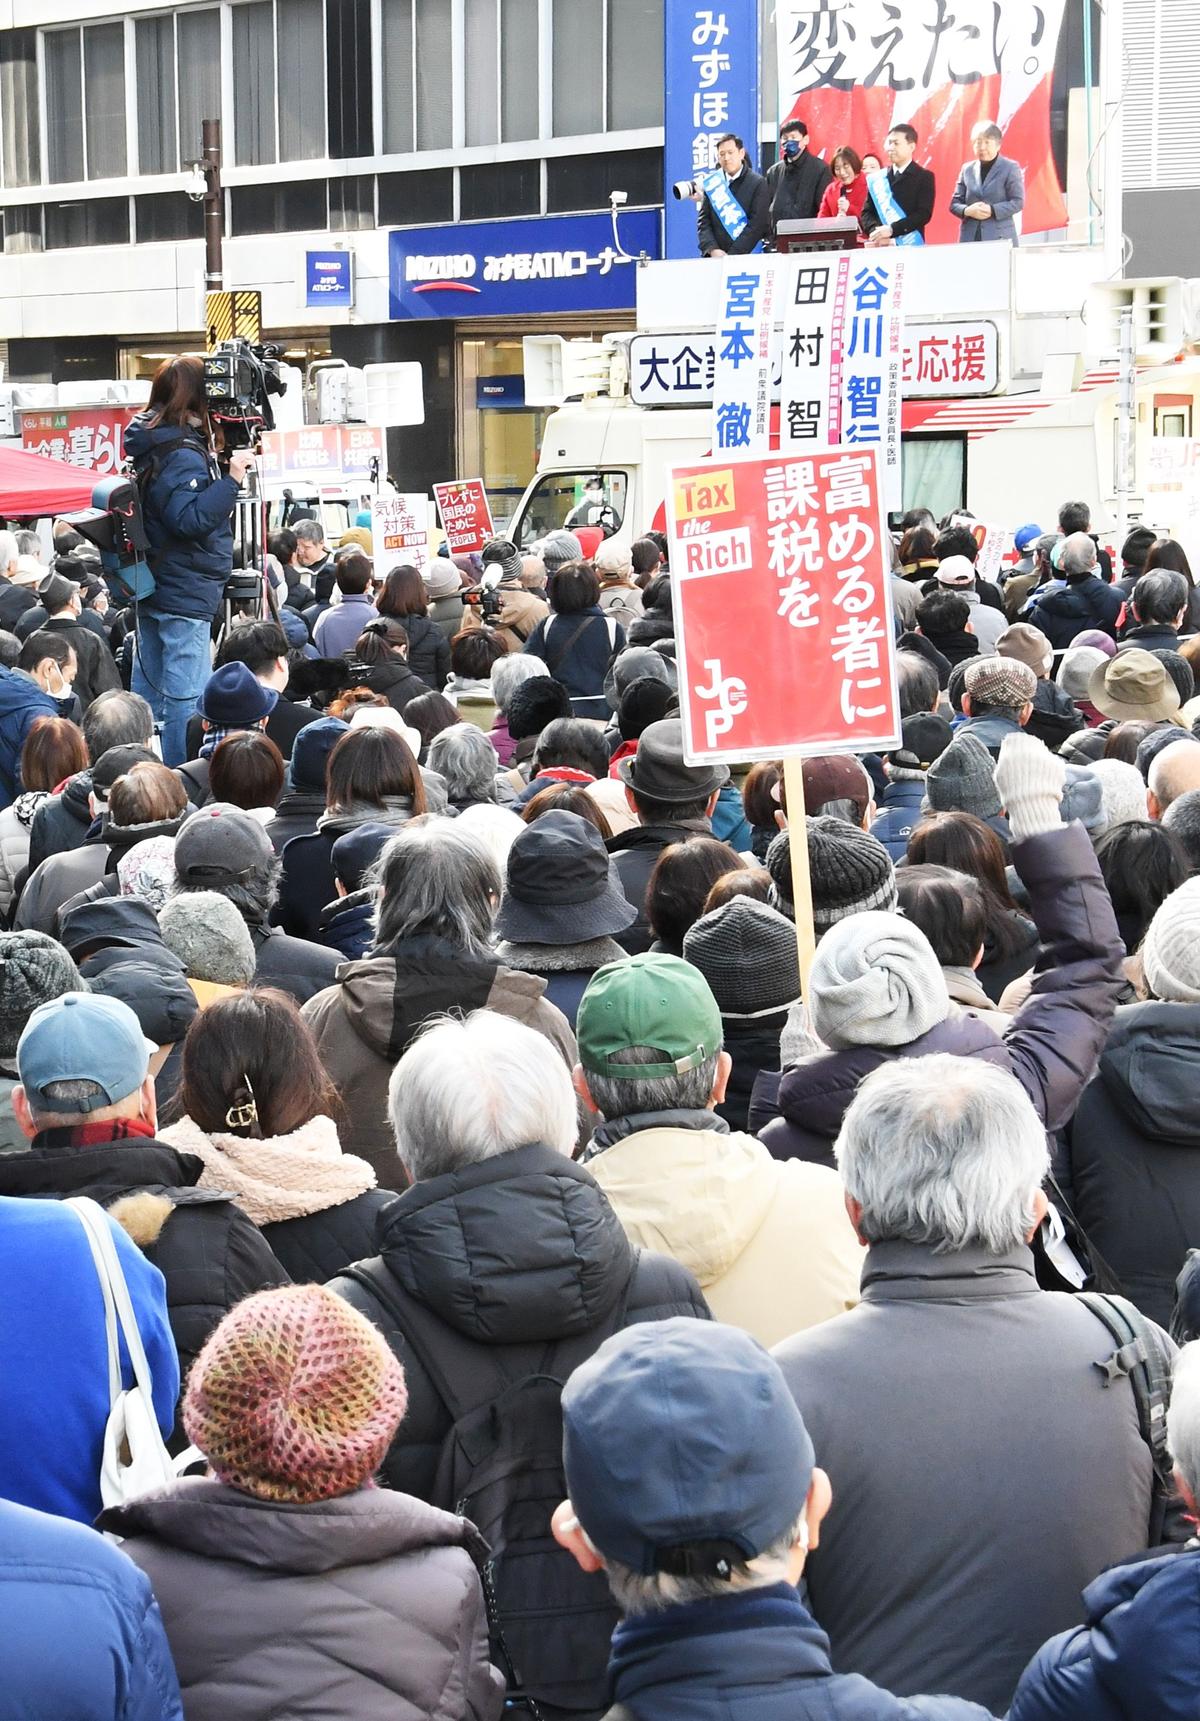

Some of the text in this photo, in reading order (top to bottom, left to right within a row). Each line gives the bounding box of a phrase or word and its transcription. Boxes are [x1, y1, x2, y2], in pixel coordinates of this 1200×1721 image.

[405, 247, 632, 281] MIZUHO みずほATMコーナー
[892, 262, 905, 310] 日本共産党
[716, 272, 760, 448] 宮本徹
[375, 497, 407, 517] 気候
[439, 488, 481, 507] ブレずに
[680, 482, 730, 513] Tax
[442, 503, 476, 520] 国民の
[384, 515, 416, 535] 対策
[445, 516, 477, 533] ために
[682, 519, 712, 537] the
[385, 532, 426, 548] ACT NOW
[450, 533, 475, 546] PEOPLE
[763, 460, 824, 628] 課税を
[686, 535, 746, 573] Rich
[819, 455, 887, 725] 富める者に
